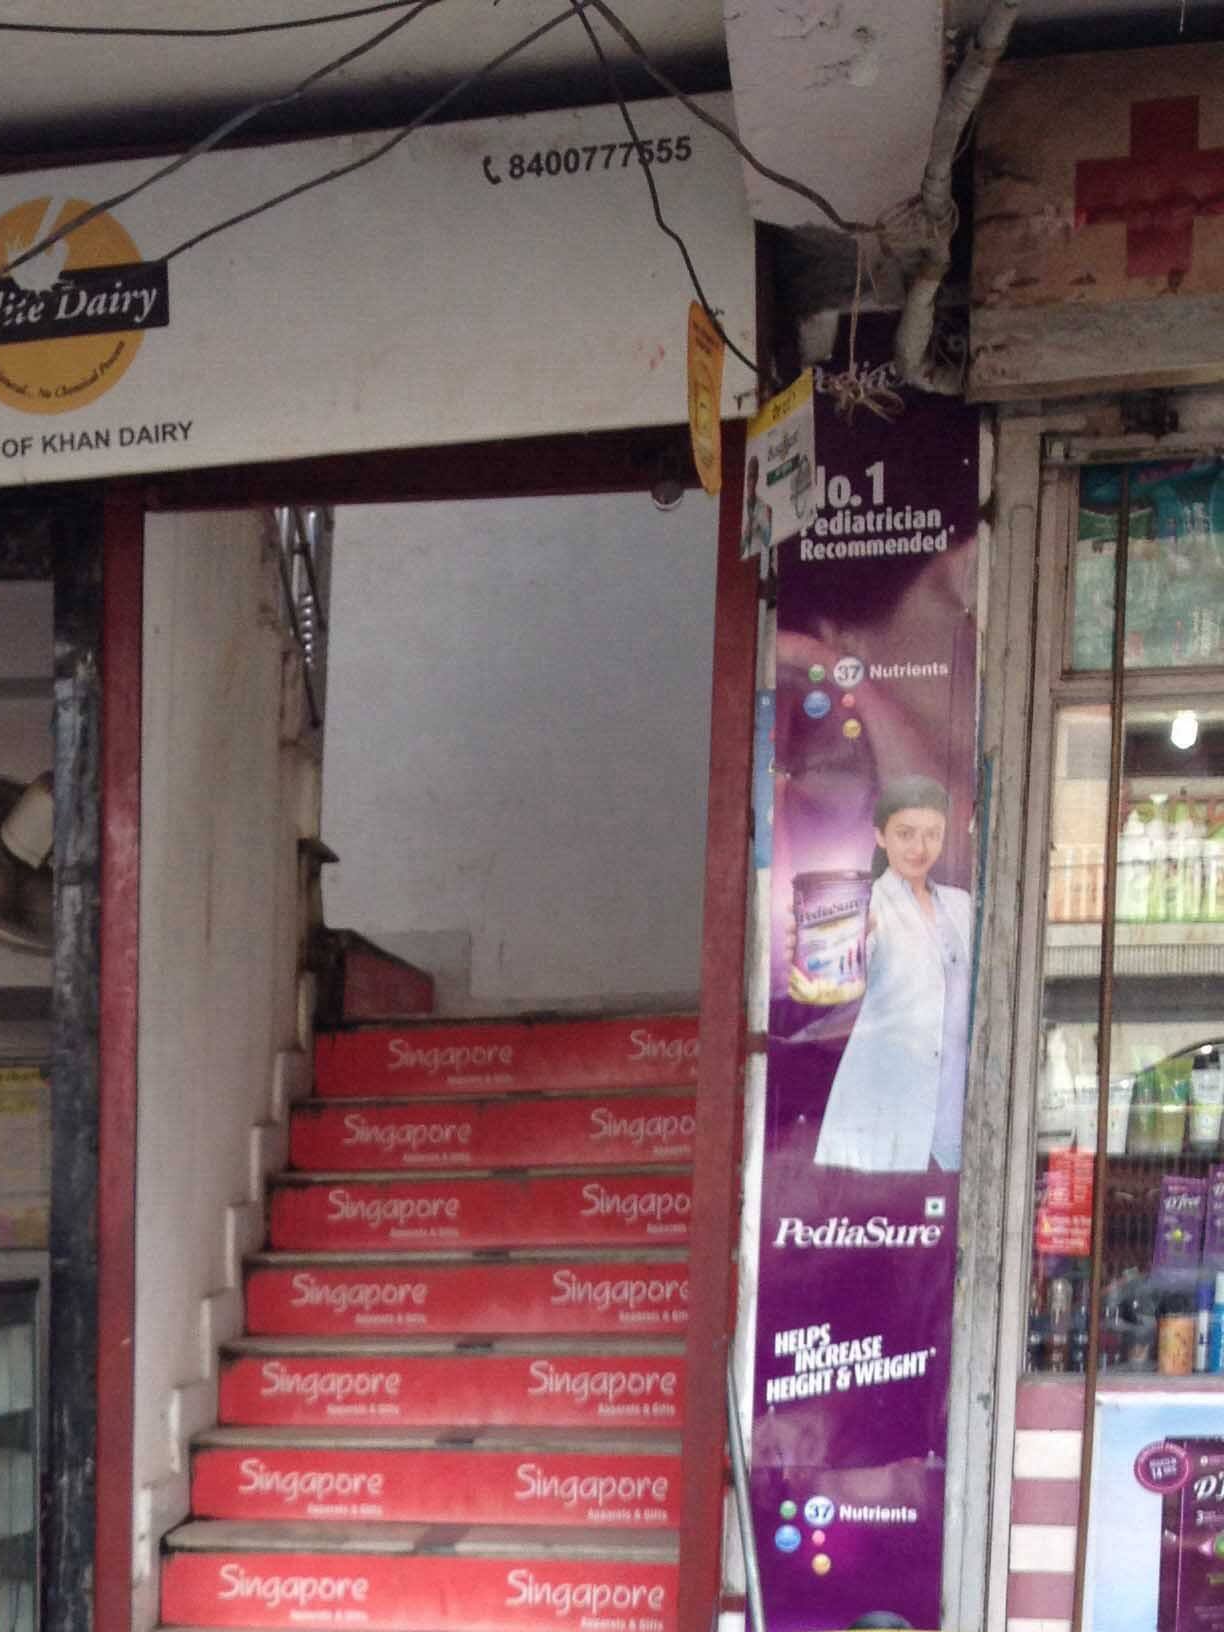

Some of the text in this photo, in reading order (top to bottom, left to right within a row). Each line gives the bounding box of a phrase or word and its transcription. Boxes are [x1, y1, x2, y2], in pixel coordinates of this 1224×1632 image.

[56, 281, 158, 323] Dairy
[2, 437, 33, 459] OF
[42, 428, 110, 454] KHAN
[119, 421, 193, 447] DAIRY
[813, 461, 885, 509] o. 1
[835, 661, 950, 683] 37 Nutrients
[388, 1039, 513, 1073] Singapore
[629, 1028, 699, 1063] Singa
[343, 1113, 472, 1150] Singapore
[590, 1107, 696, 1145] Singapo
[328, 1189, 460, 1228] Singapore
[581, 1183, 691, 1222] Singapo
[772, 1216, 942, 1250] PediaSure
[291, 1272, 428, 1313] Singapore
[775, 1322, 831, 1357] HELPS
[794, 1334, 883, 1374] INCREASE
[261, 1361, 401, 1403] Singapore
[527, 1360, 677, 1403] Singapore
[766, 1369, 834, 1404] HEIGHT
[836, 1365, 852, 1391] &
[239, 1458, 383, 1503] Singapore
[514, 1463, 669, 1509] Singapore
[839, 1504, 917, 1522] Nutrients
[218, 1563, 369, 1608] Singapore
[506, 1568, 665, 1617] Singapore
